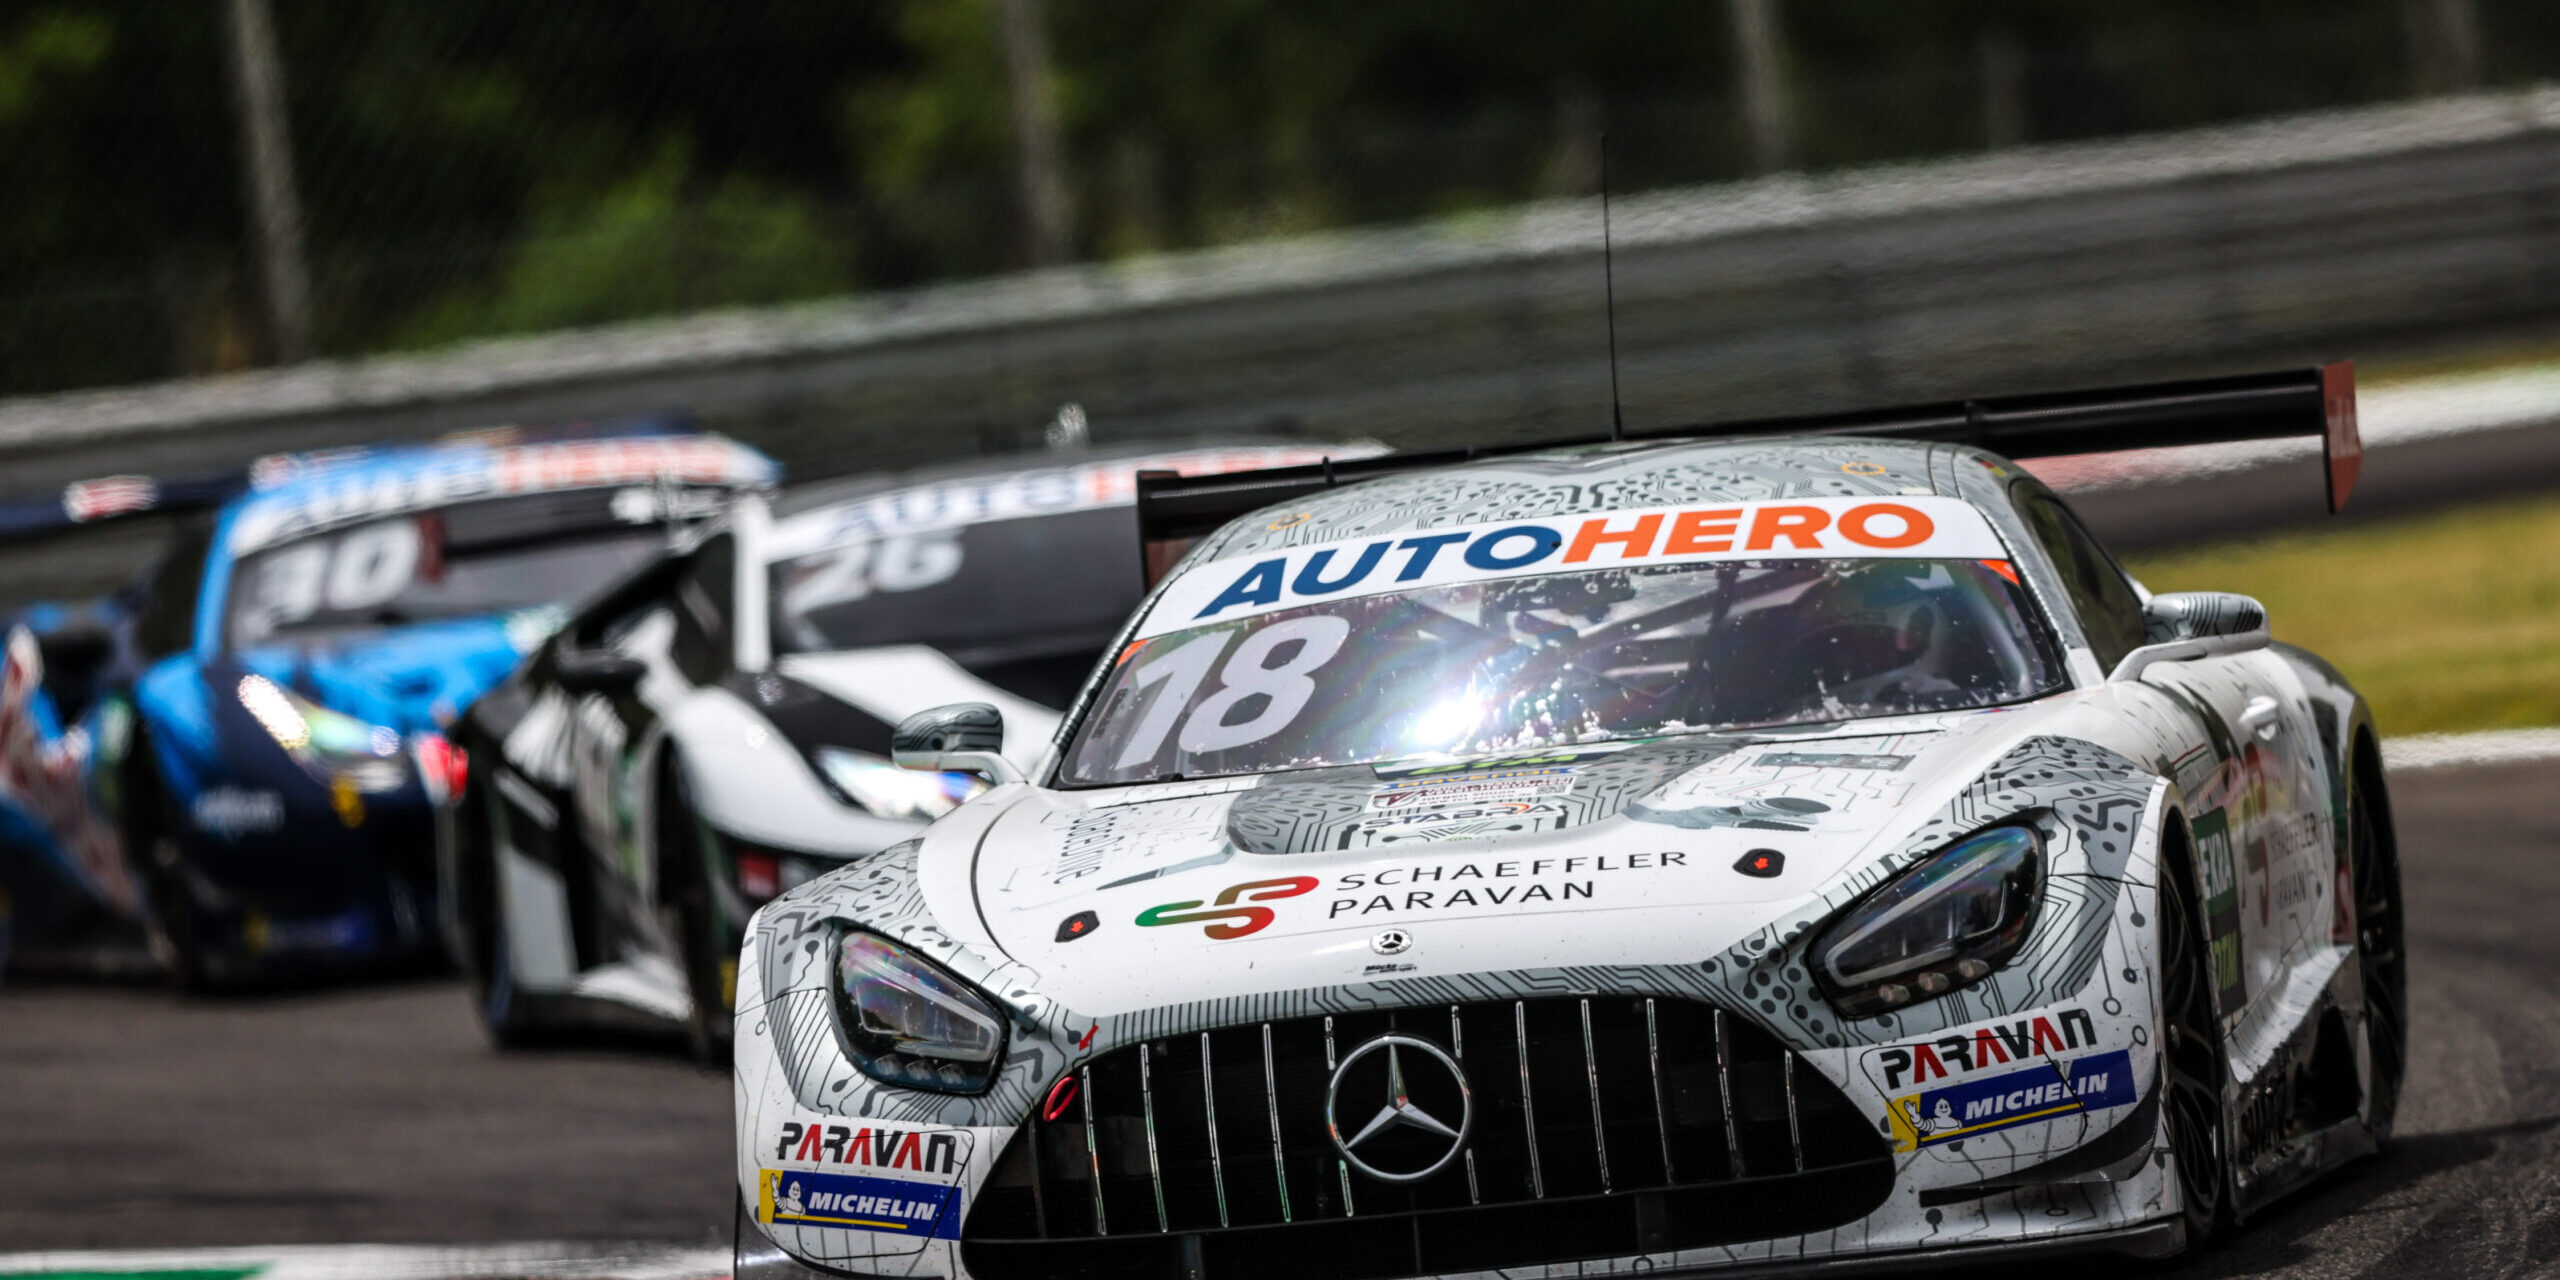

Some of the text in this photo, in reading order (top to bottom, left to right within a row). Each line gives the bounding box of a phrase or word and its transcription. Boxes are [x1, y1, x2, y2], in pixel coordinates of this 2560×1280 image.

[1196, 503, 1935, 620] AUTOHERO
[1116, 616, 1350, 770] 18
[1363, 803, 1558, 829] STABRA
[1336, 850, 1689, 892] SCHAEFFLER
[2197, 828, 2233, 901] EKRA
[1328, 880, 1594, 920] PARAVAN
[1880, 1008, 2098, 1090] PARAVAN
[1965, 1072, 2109, 1121] MICHELIN
[777, 1122, 958, 1174] PARAVAN
[808, 1191, 938, 1221] MICHELIN
